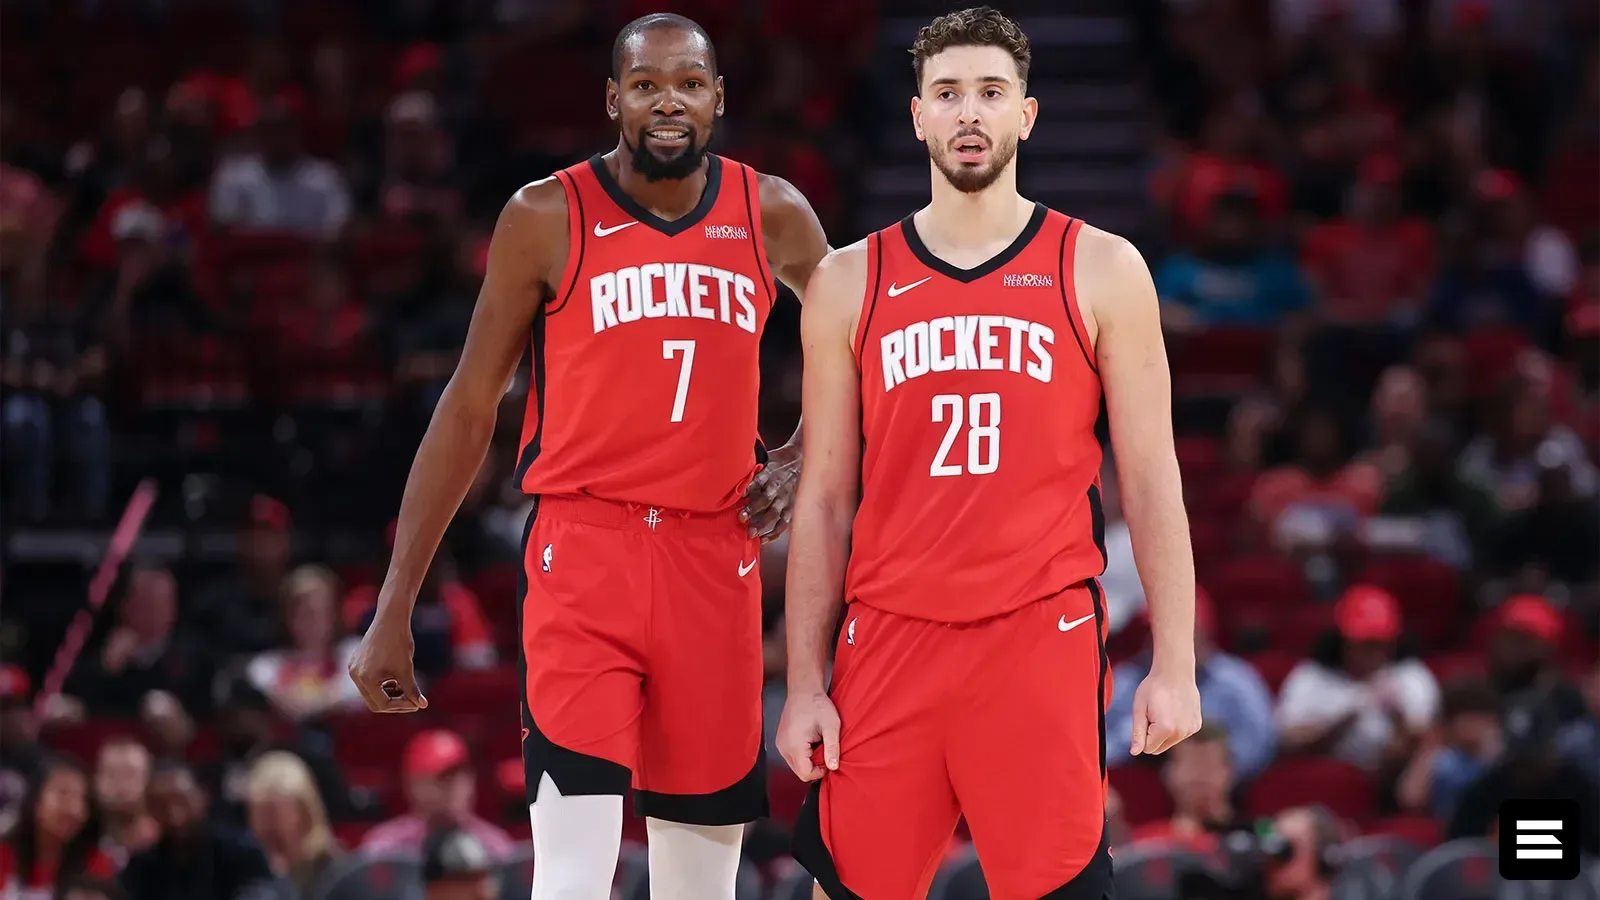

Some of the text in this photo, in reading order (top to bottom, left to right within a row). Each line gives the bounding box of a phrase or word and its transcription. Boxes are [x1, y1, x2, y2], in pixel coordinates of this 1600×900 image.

[705, 225, 746, 234] MEMORIAL
[705, 230, 748, 239] HERMANN
[590, 263, 756, 334] ROCKETS
[1003, 279, 1053, 287] HERMANN
[662, 340, 696, 422] 7
[880, 315, 1055, 393] ROCKETS
[930, 392, 1001, 477] 28
